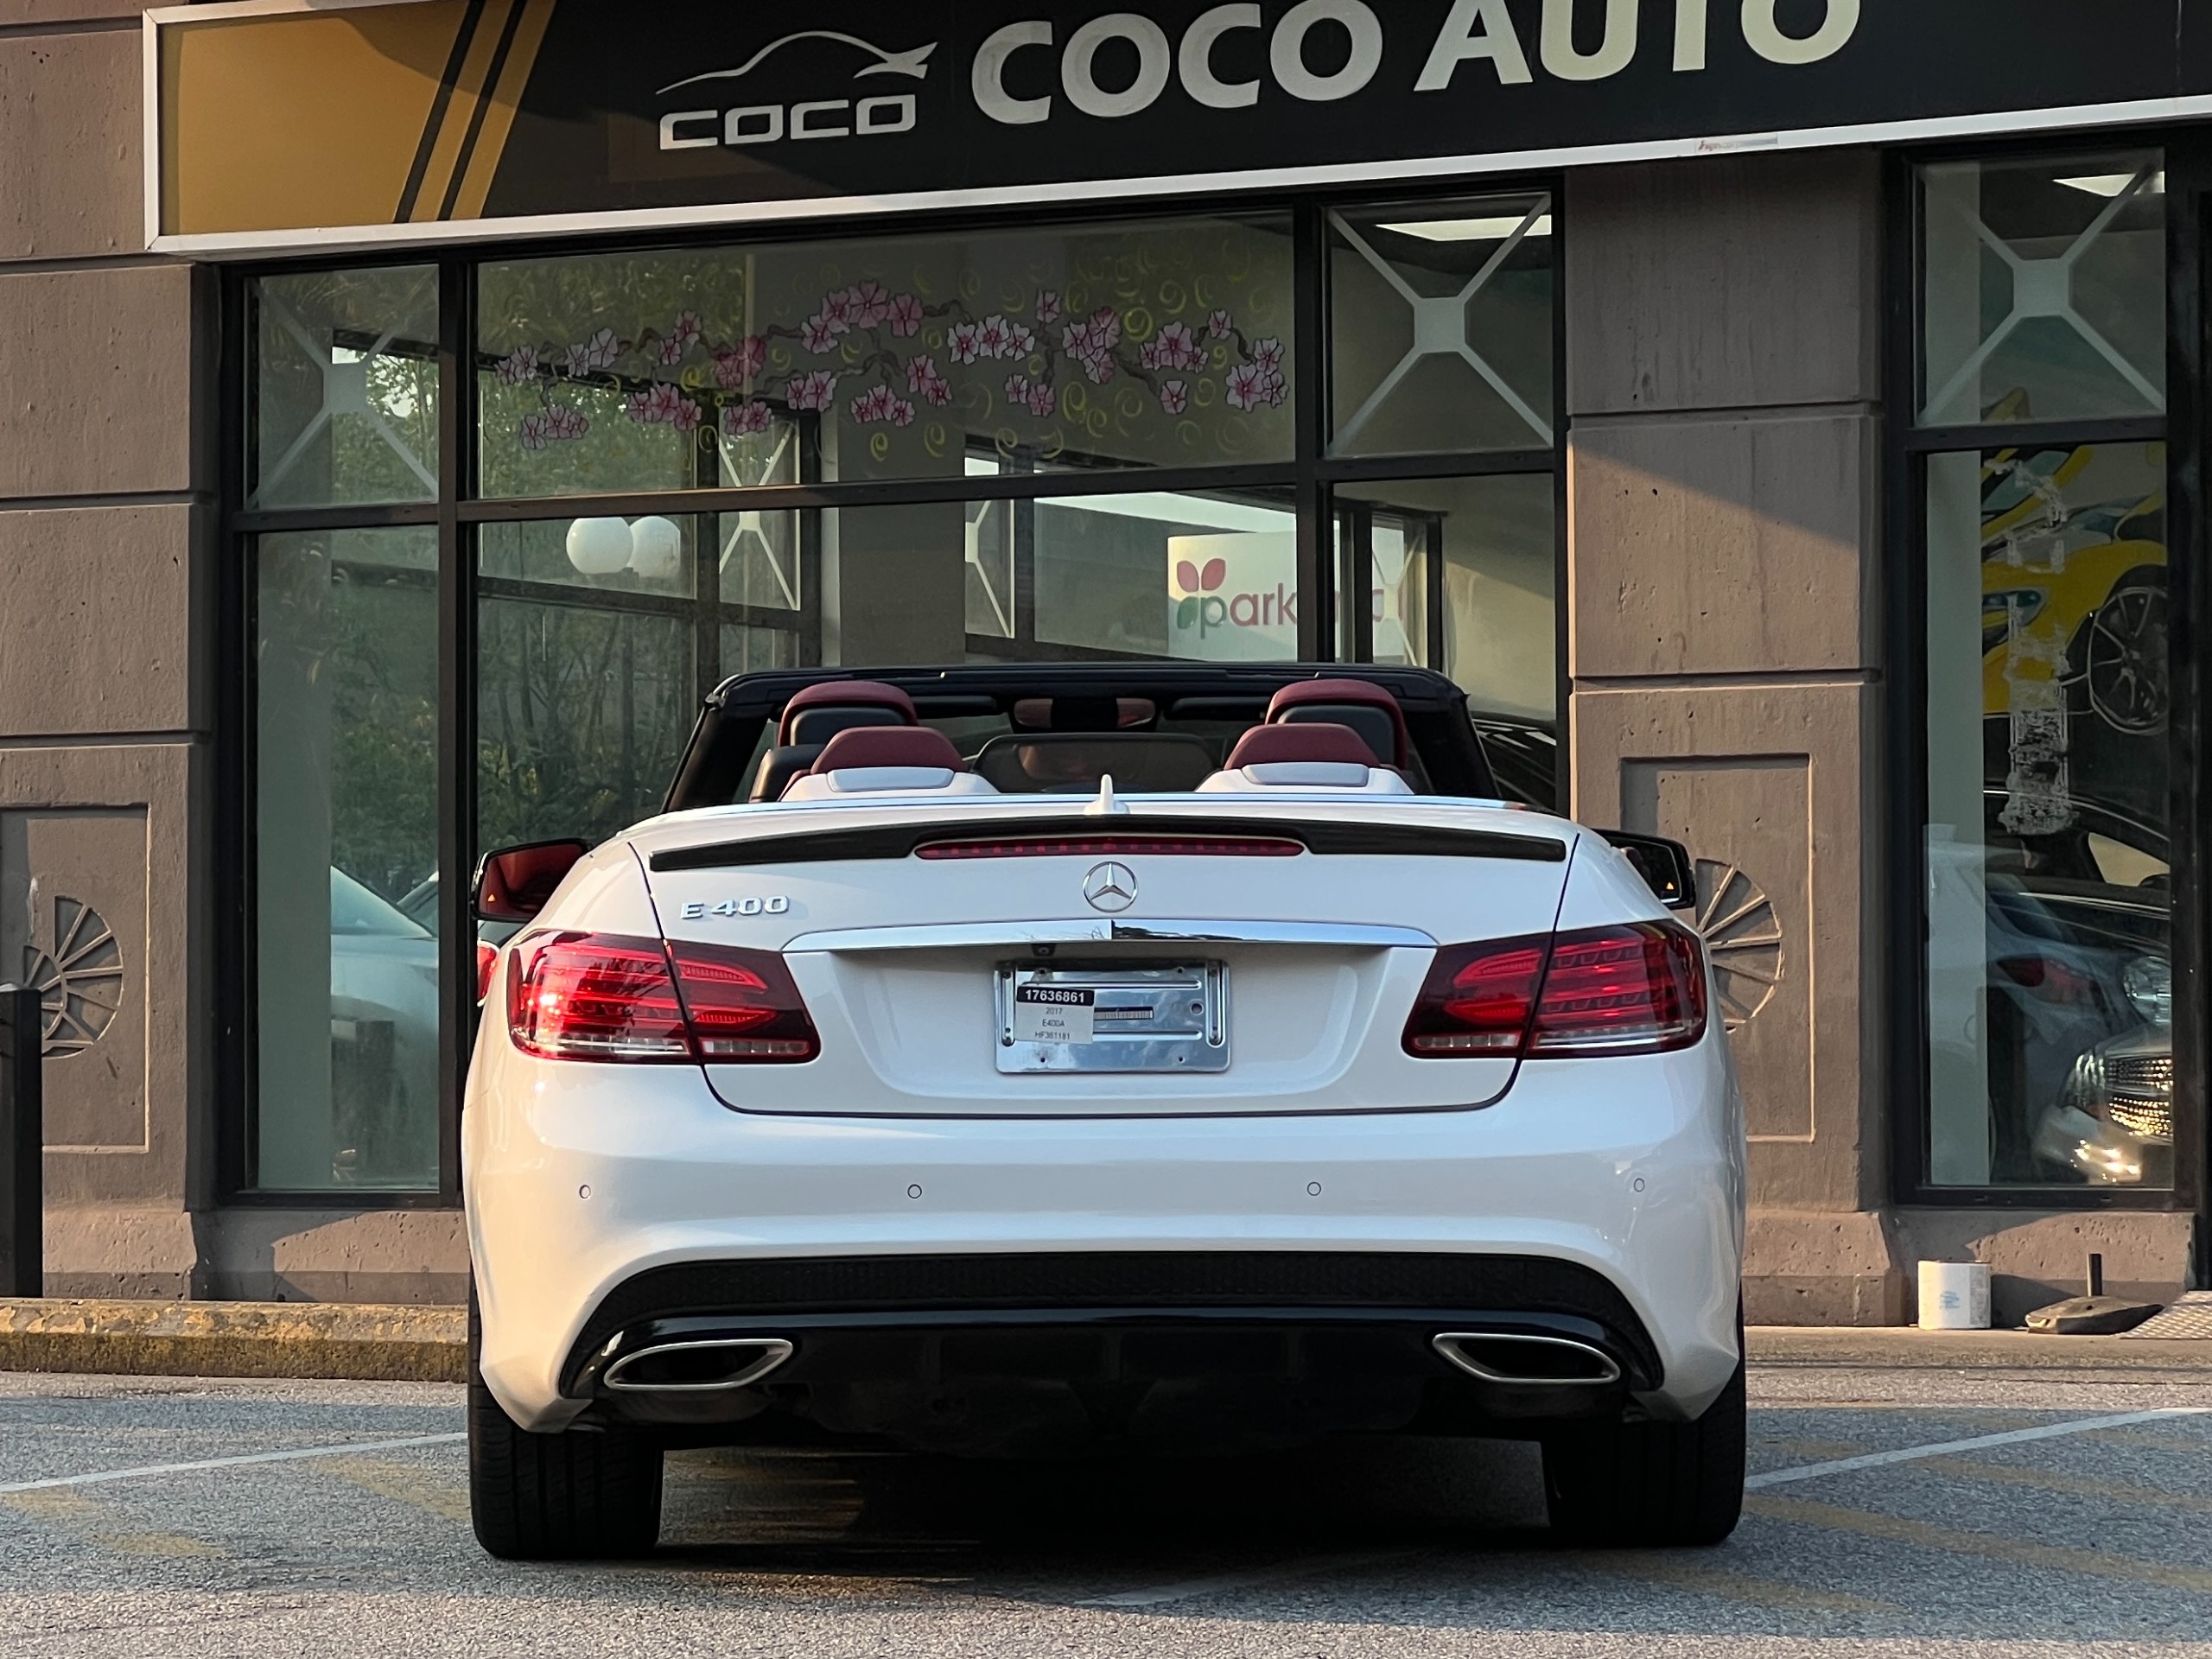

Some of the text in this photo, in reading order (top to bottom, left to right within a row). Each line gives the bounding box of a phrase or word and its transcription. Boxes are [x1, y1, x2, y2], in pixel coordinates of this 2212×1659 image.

[971, 0, 1860, 124] COCO AUTO
[659, 94, 916, 150] COCO
[680, 895, 790, 919] E 400
[1025, 989, 1084, 1003] 17636861
[1046, 1007, 1063, 1015] 2017
